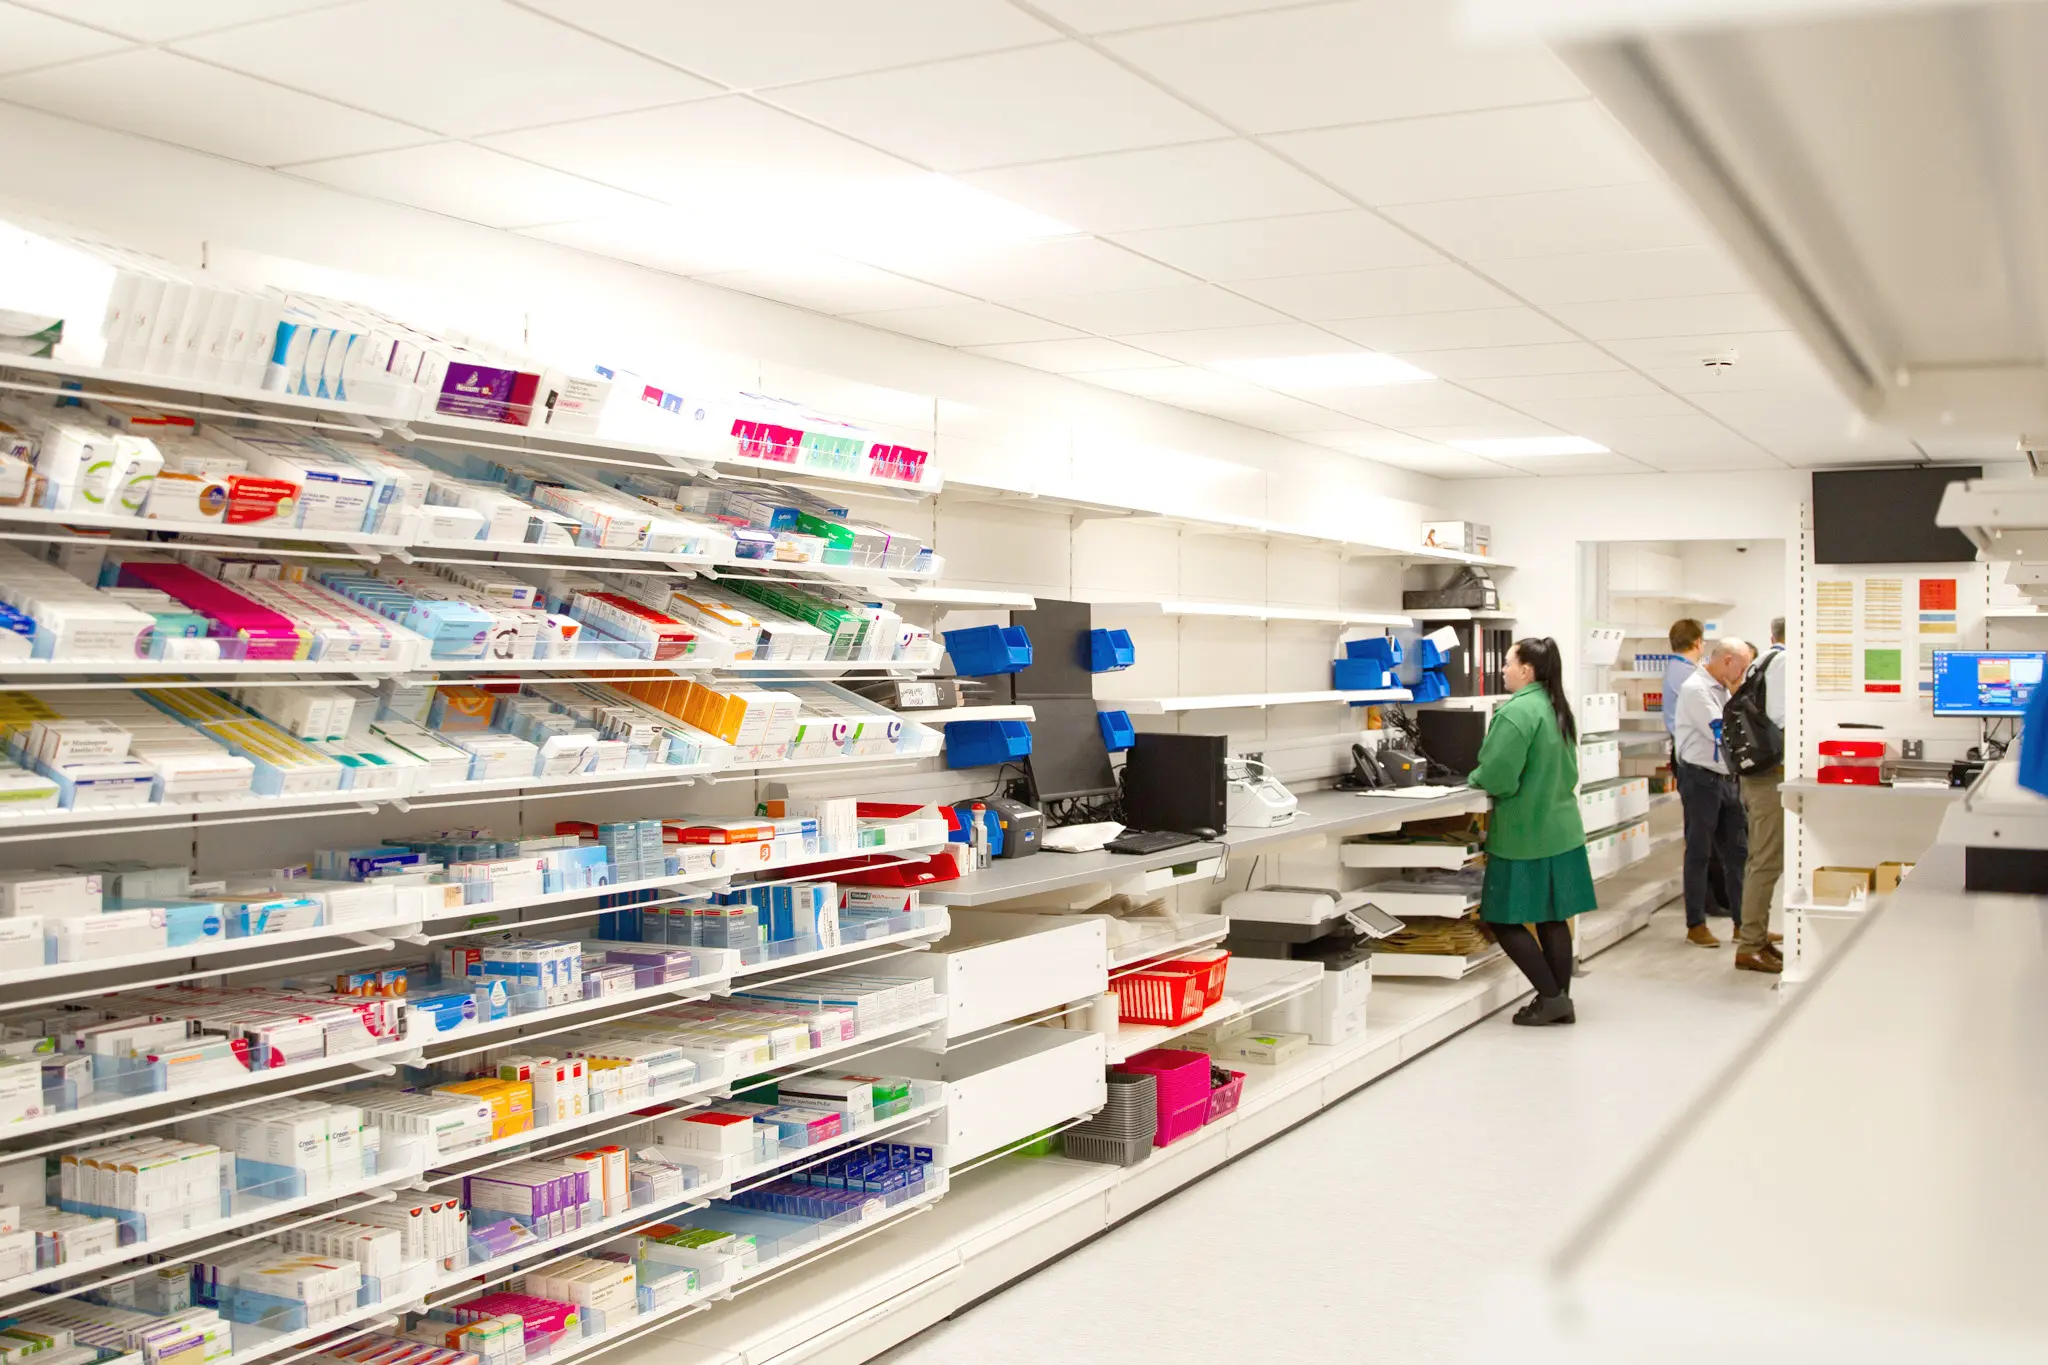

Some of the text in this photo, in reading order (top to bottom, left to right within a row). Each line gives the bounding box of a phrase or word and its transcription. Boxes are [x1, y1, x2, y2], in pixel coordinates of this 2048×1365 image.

[332, 1130, 349, 1140] Creon
[298, 1138, 316, 1149] Creon
[525, 1316, 555, 1327] Trimethoprim
